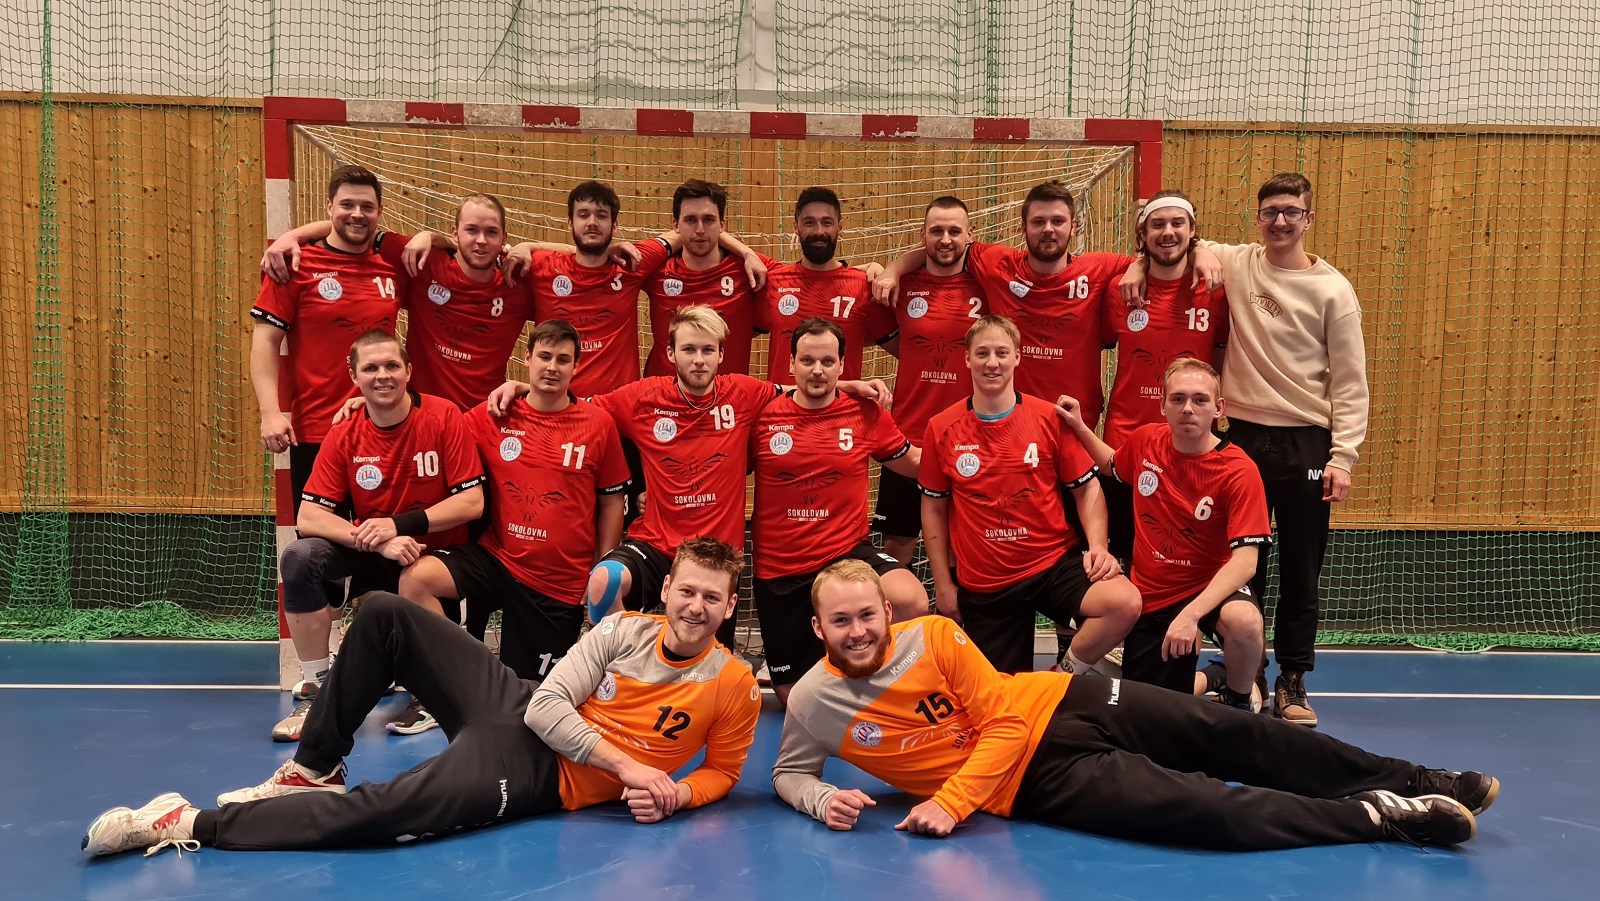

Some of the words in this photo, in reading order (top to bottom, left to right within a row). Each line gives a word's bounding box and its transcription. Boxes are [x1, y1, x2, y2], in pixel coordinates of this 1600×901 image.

[312, 270, 339, 279] Kempa
[610, 272, 623, 291] 3
[372, 276, 396, 300] 14
[720, 276, 734, 296] 9
[777, 286, 801, 294] Kempa
[1067, 275, 1089, 299] 16
[491, 297, 504, 317] 8
[830, 295, 856, 319] 17
[968, 297, 983, 318] 2
[266, 314, 285, 328] Kempa
[1185, 307, 1210, 332] 13
[435, 343, 472, 361] SOKOLOVNA
[580, 341, 603, 350] LOVNA
[1022, 345, 1063, 356] SOKOLOVNA
[921, 370, 957, 381] SOKOLOVNA
[1140, 386, 1163, 395] SOKOL
[654, 408, 679, 417] Kempa
[709, 404, 736, 431] 19
[500, 426, 526, 437] Kempa
[838, 428, 854, 451] 5
[560, 442, 586, 470] 11
[955, 444, 979, 452] Kempa
[1023, 442, 1040, 468] 4
[353, 455, 381, 463] Kempa
[413, 450, 439, 477] 10
[1142, 458, 1164, 474] Kempa
[461, 479, 479, 489] Kempa
[1078, 471, 1093, 484] Kempa
[674, 493, 717, 504] SOKOLOVNA
[787, 509, 829, 518] SOKOLOVNA
[1194, 496, 1214, 521] 6
[507, 522, 547, 539] SOKOLOVNA
[985, 527, 1028, 538] SOKOLOVNA
[538, 652, 561, 676] 1
[770, 664, 791, 673] Kempa
[889, 650, 918, 676] Kempa
[914, 691, 955, 724] 15
[652, 705, 691, 741] 12
[497, 778, 508, 817] hummel
